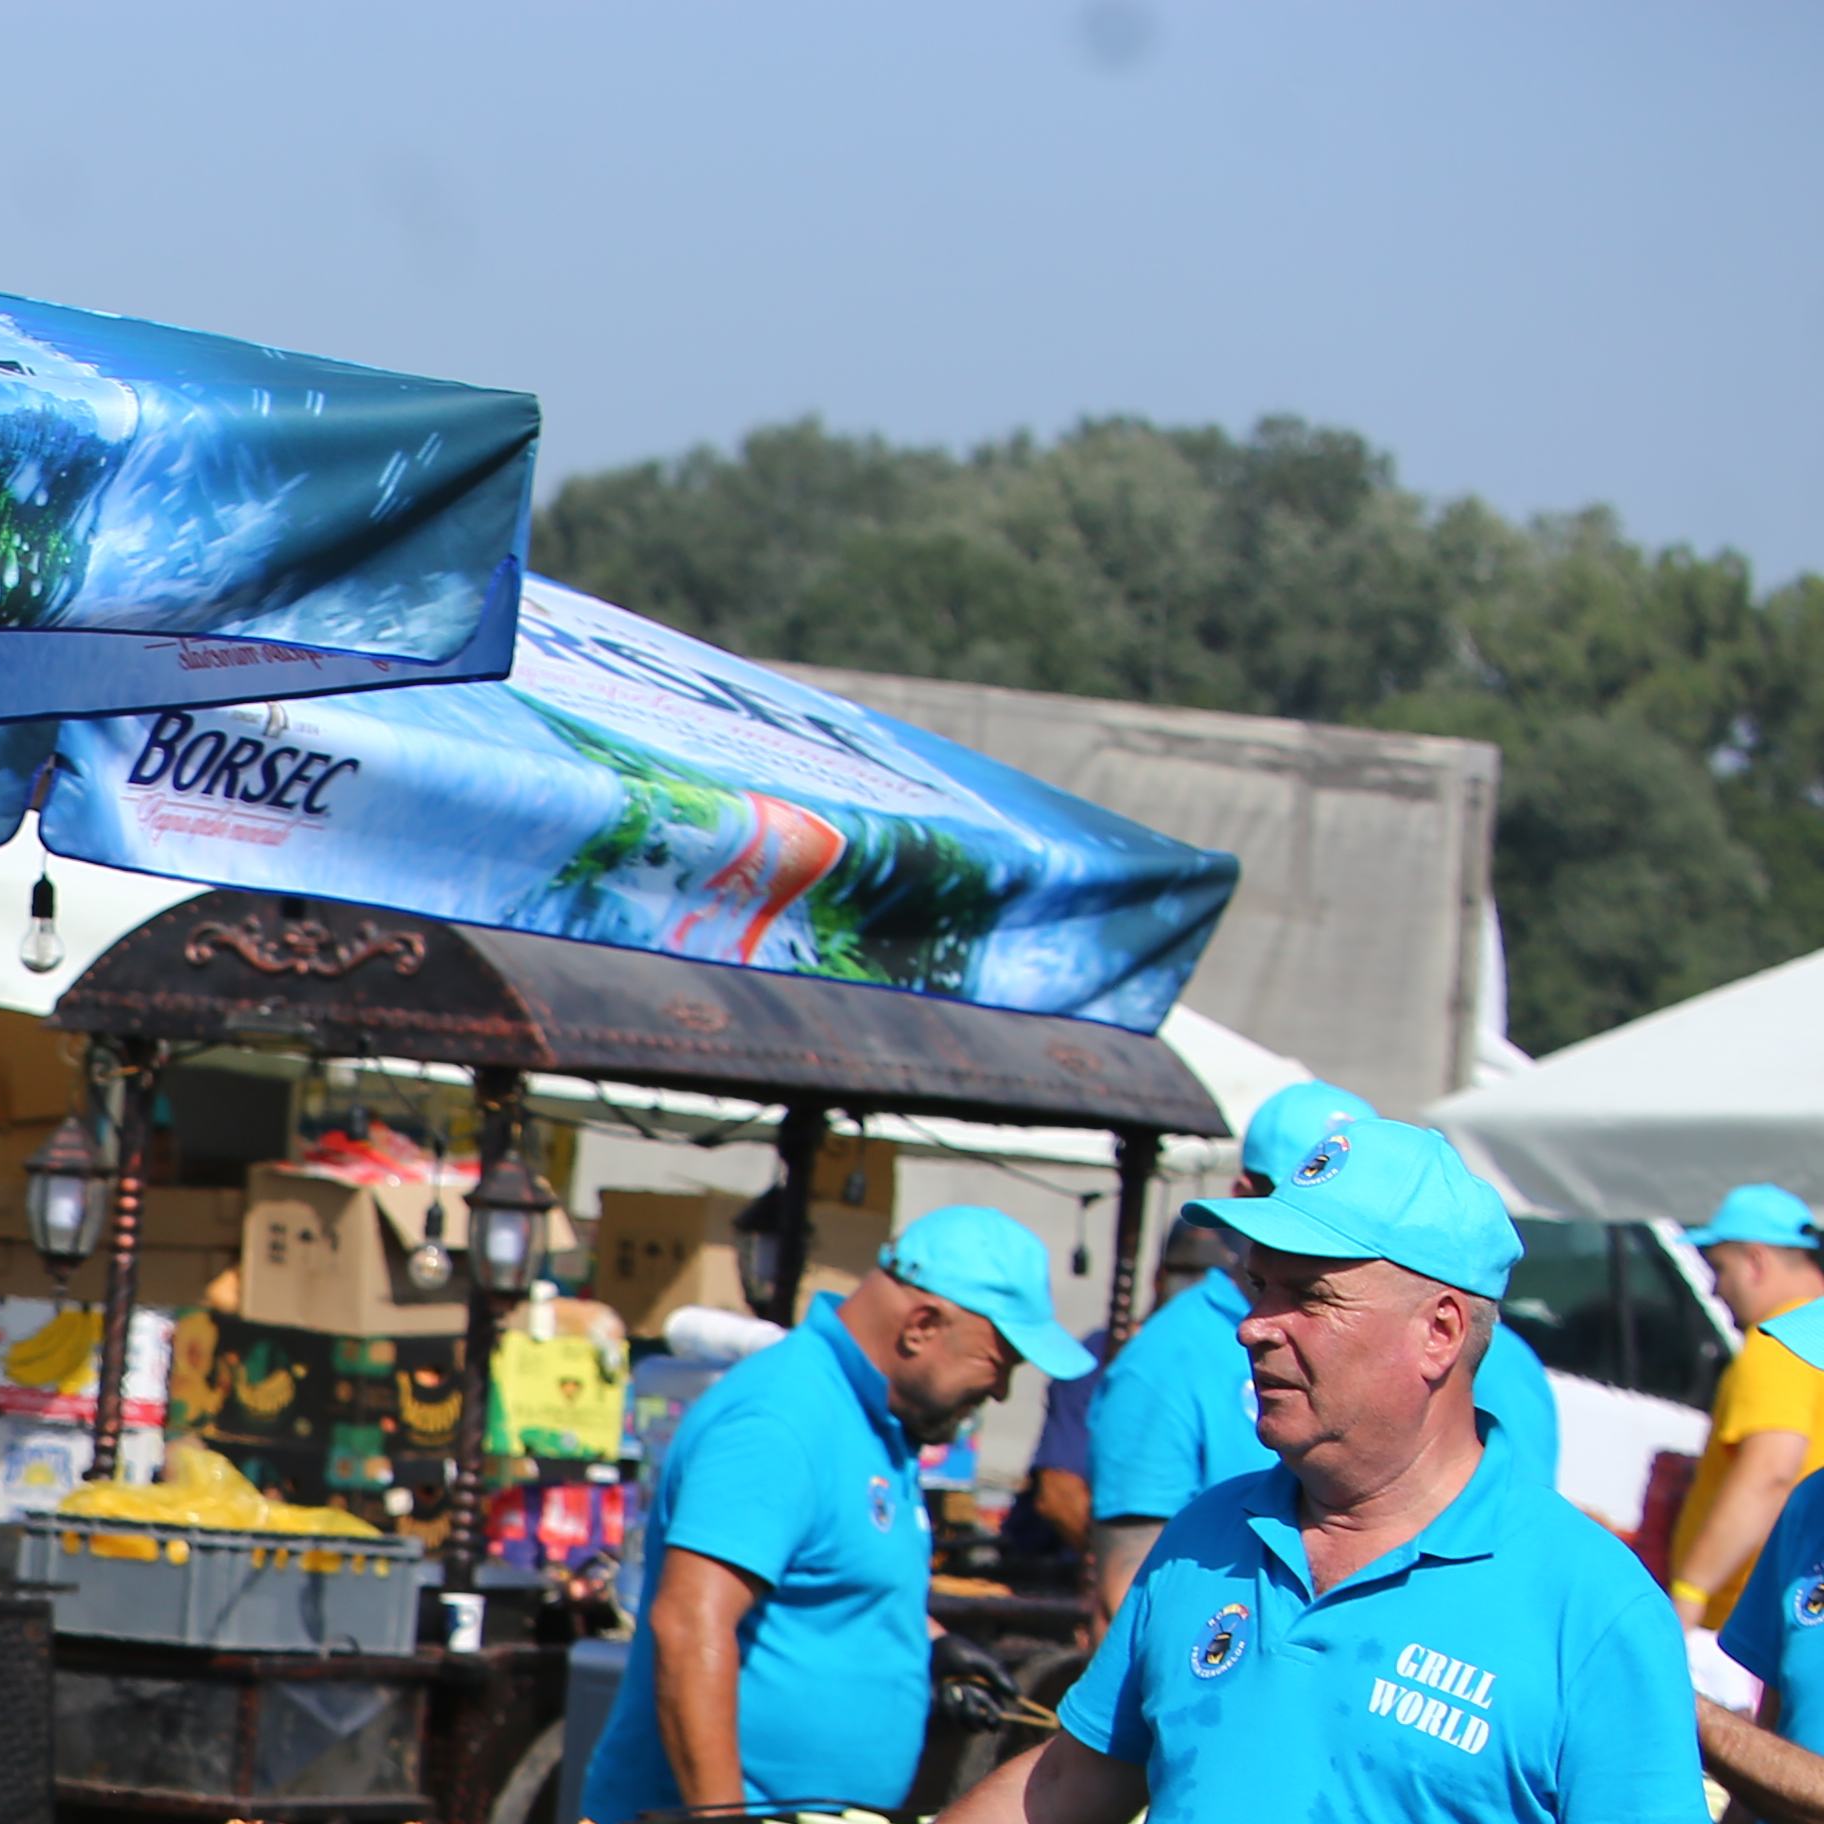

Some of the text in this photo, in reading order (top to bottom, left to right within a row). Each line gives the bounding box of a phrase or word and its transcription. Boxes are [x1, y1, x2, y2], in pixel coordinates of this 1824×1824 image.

[126, 709, 360, 816] BORSEC
[1396, 1643, 1497, 1709] GRILL
[1368, 1677, 1490, 1755] WORLD
